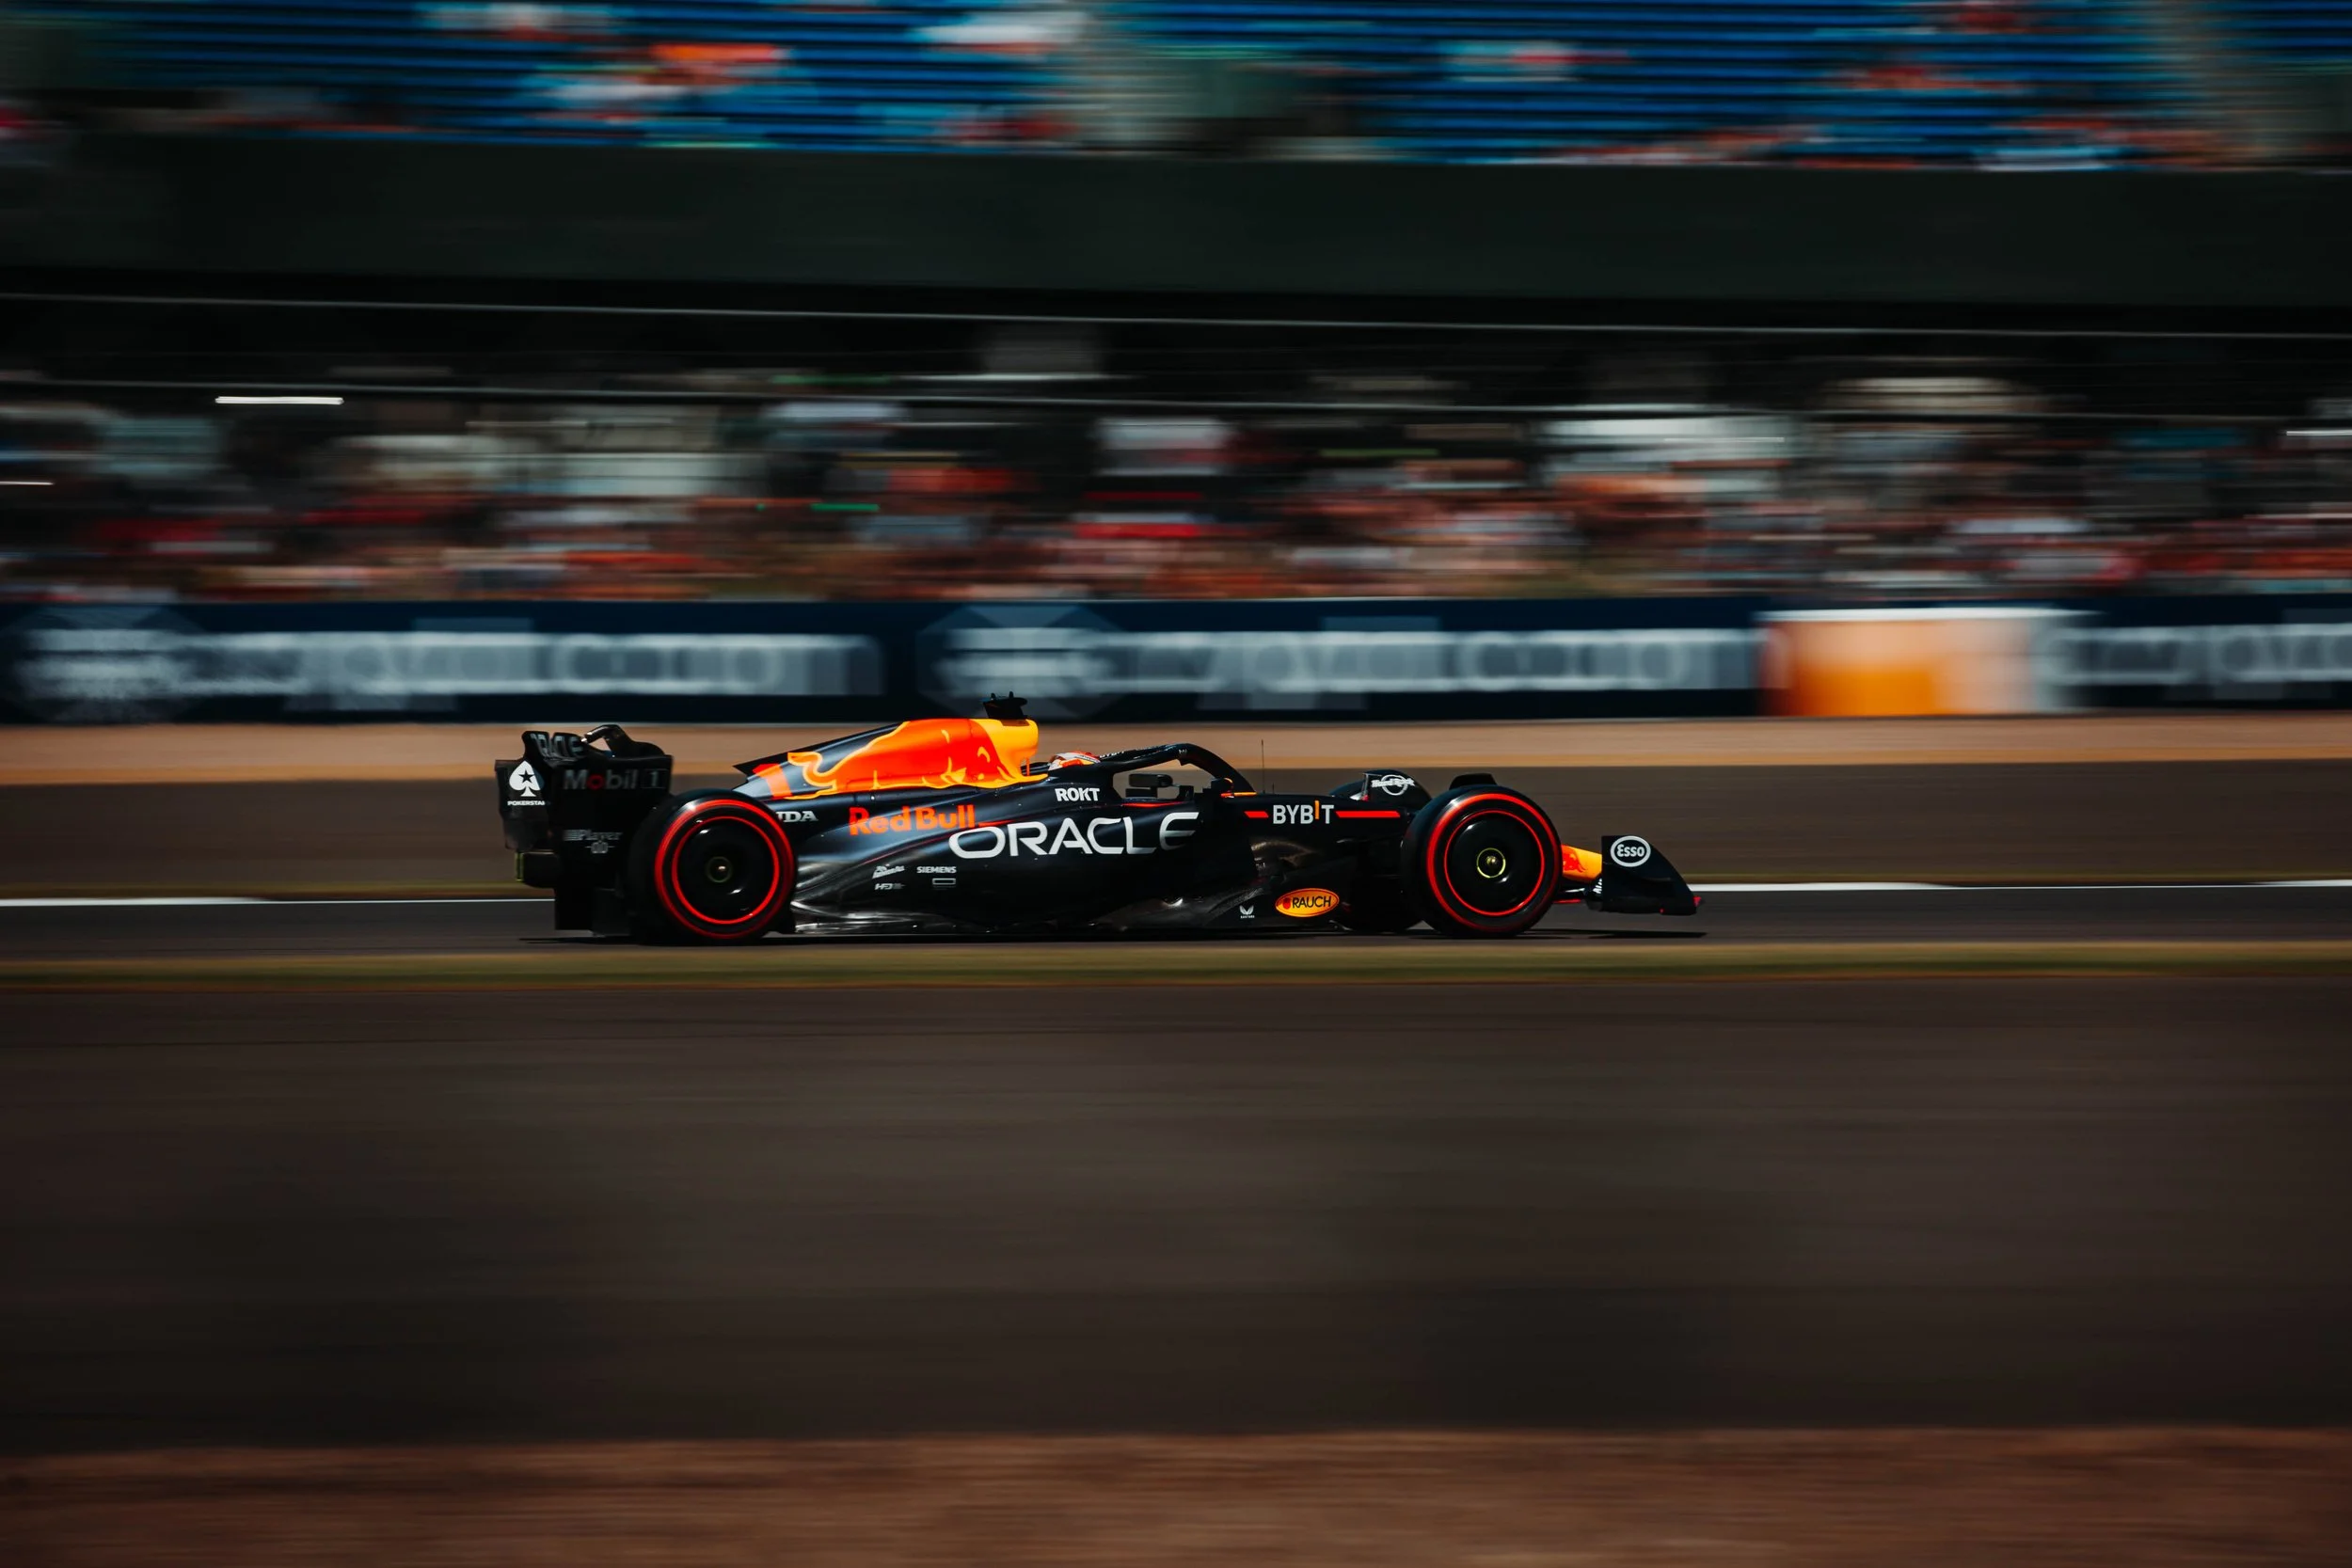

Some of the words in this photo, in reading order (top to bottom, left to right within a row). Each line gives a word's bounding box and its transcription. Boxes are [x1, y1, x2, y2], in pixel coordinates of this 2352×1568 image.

[563, 769, 638, 790] Mobil
[1055, 787, 1101, 801] ROKT
[848, 806, 911, 836] Red
[914, 804, 976, 831] Bull
[1273, 800, 1335, 824] BYBIT
[948, 812, 1200, 859] ORACLE
[916, 865, 957, 874] SIEMENS
[1292, 895, 1332, 909] RAUCH
